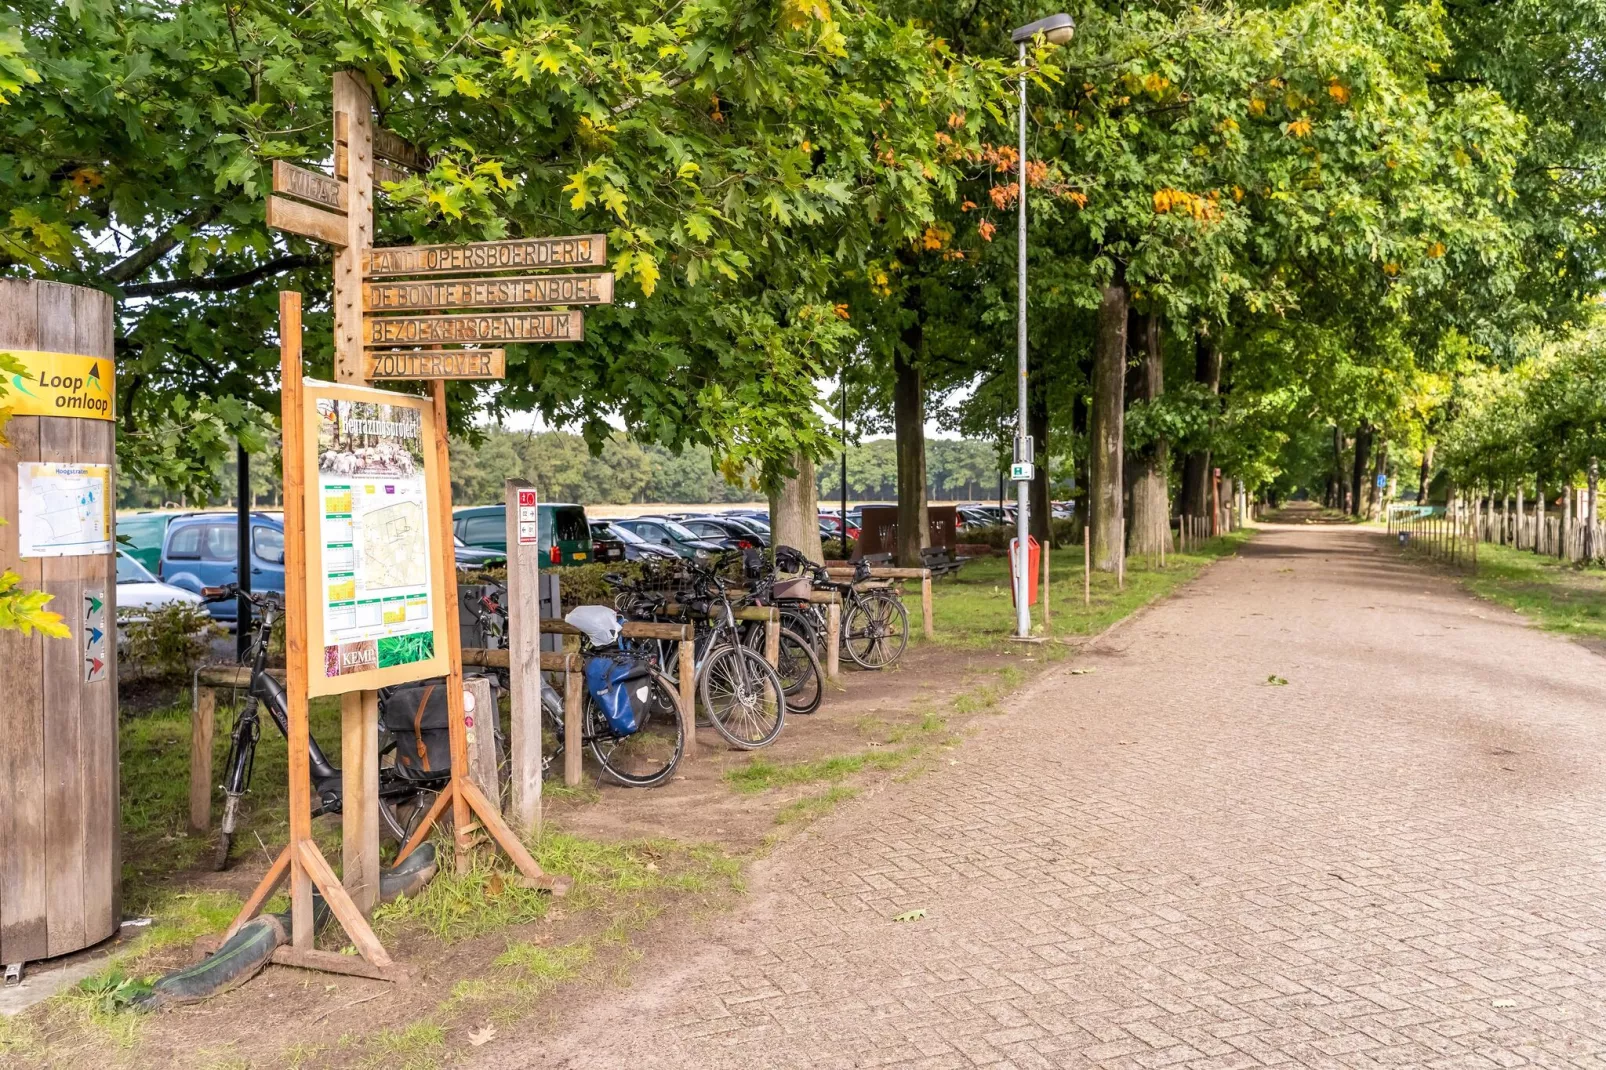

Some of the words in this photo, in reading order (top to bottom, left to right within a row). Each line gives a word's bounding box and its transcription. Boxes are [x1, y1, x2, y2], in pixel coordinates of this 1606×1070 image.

[369, 238, 593, 274] LANDLOPERSBOERDERIJ
[371, 285, 392, 308] DE
[397, 283, 457, 306] BONTE
[461, 275, 601, 304] BEESTENBOEL
[371, 313, 571, 343] BEZOEKERSCENTRUM
[371, 351, 493, 377] ZOUTEROVER
[39, 371, 83, 394] Loop
[55, 392, 108, 416] omloop
